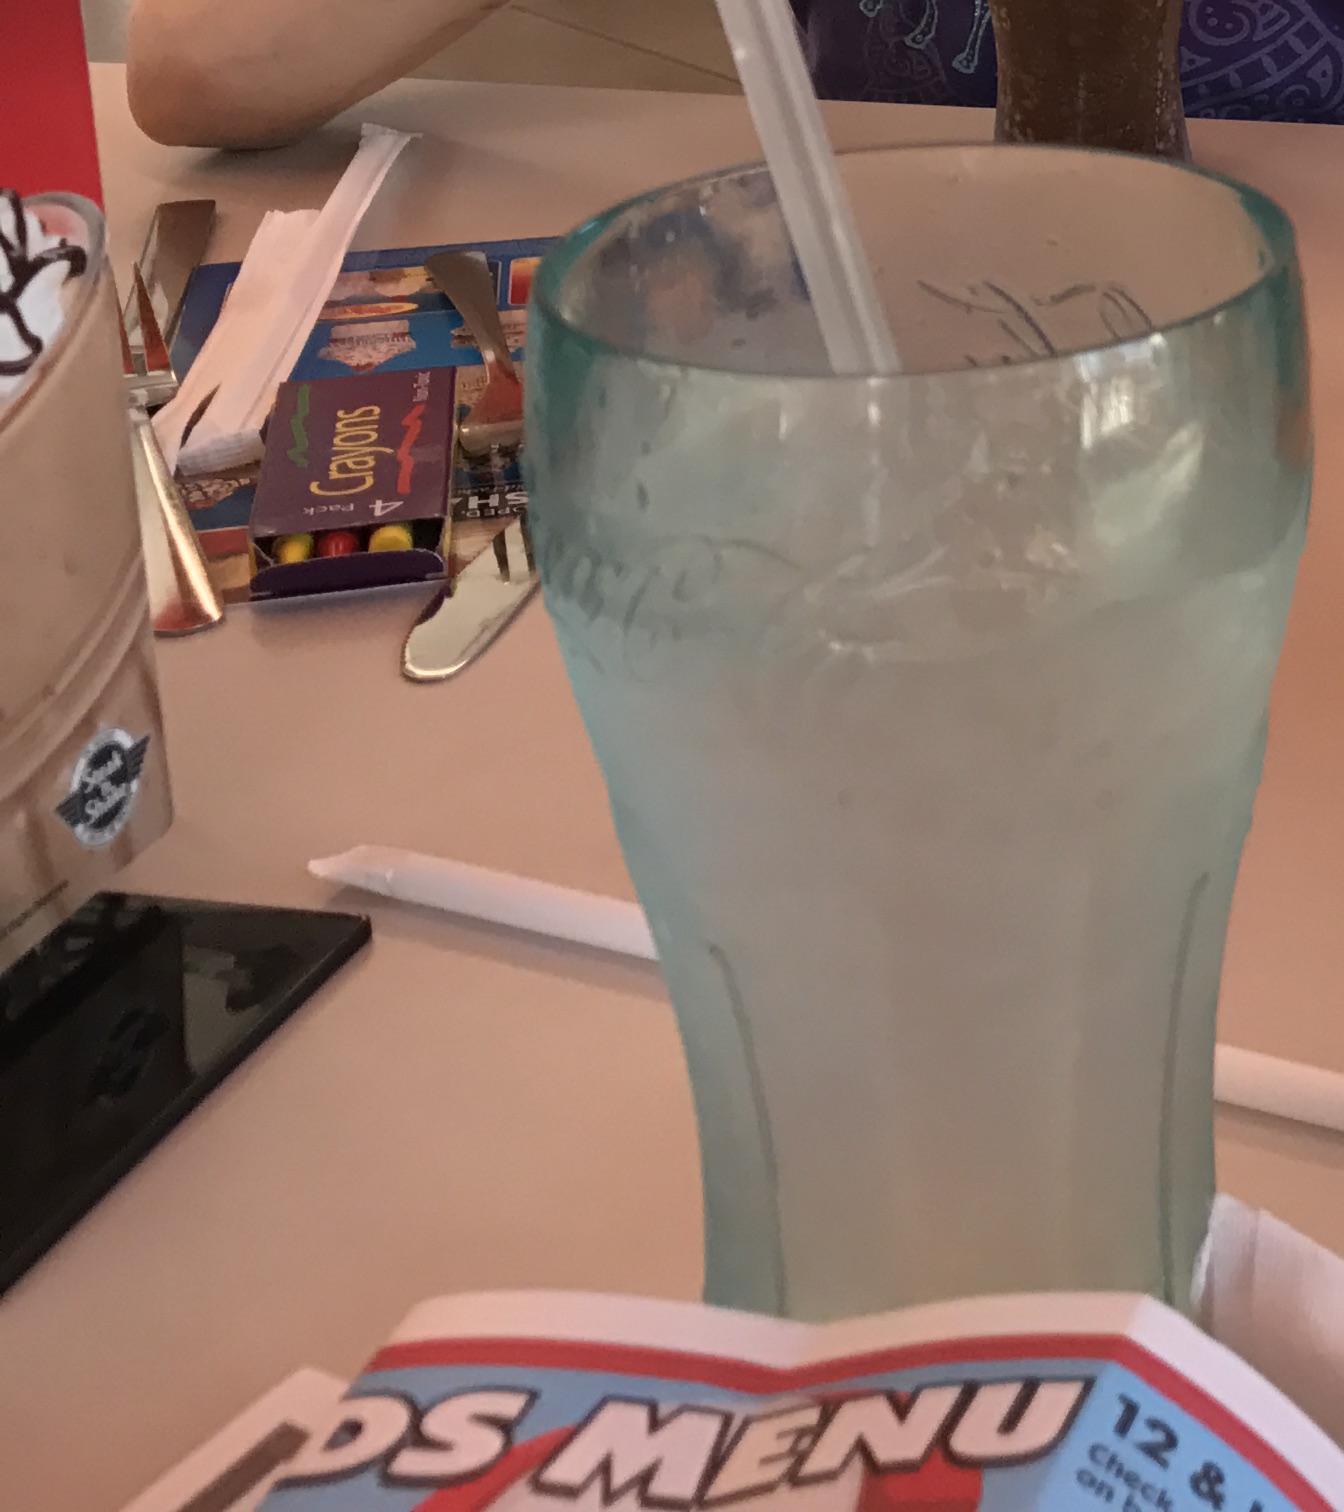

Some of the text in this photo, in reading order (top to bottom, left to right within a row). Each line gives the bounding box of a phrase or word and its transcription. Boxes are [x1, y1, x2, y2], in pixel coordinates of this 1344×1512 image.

[309, 405, 394, 497] Crayons
[302, 499, 405, 517] 4 Pack
[530, 1374, 1097, 1512] MENU
[1088, 1443, 1174, 1512] Check
[1112, 1392, 1226, 1512] 12 &
